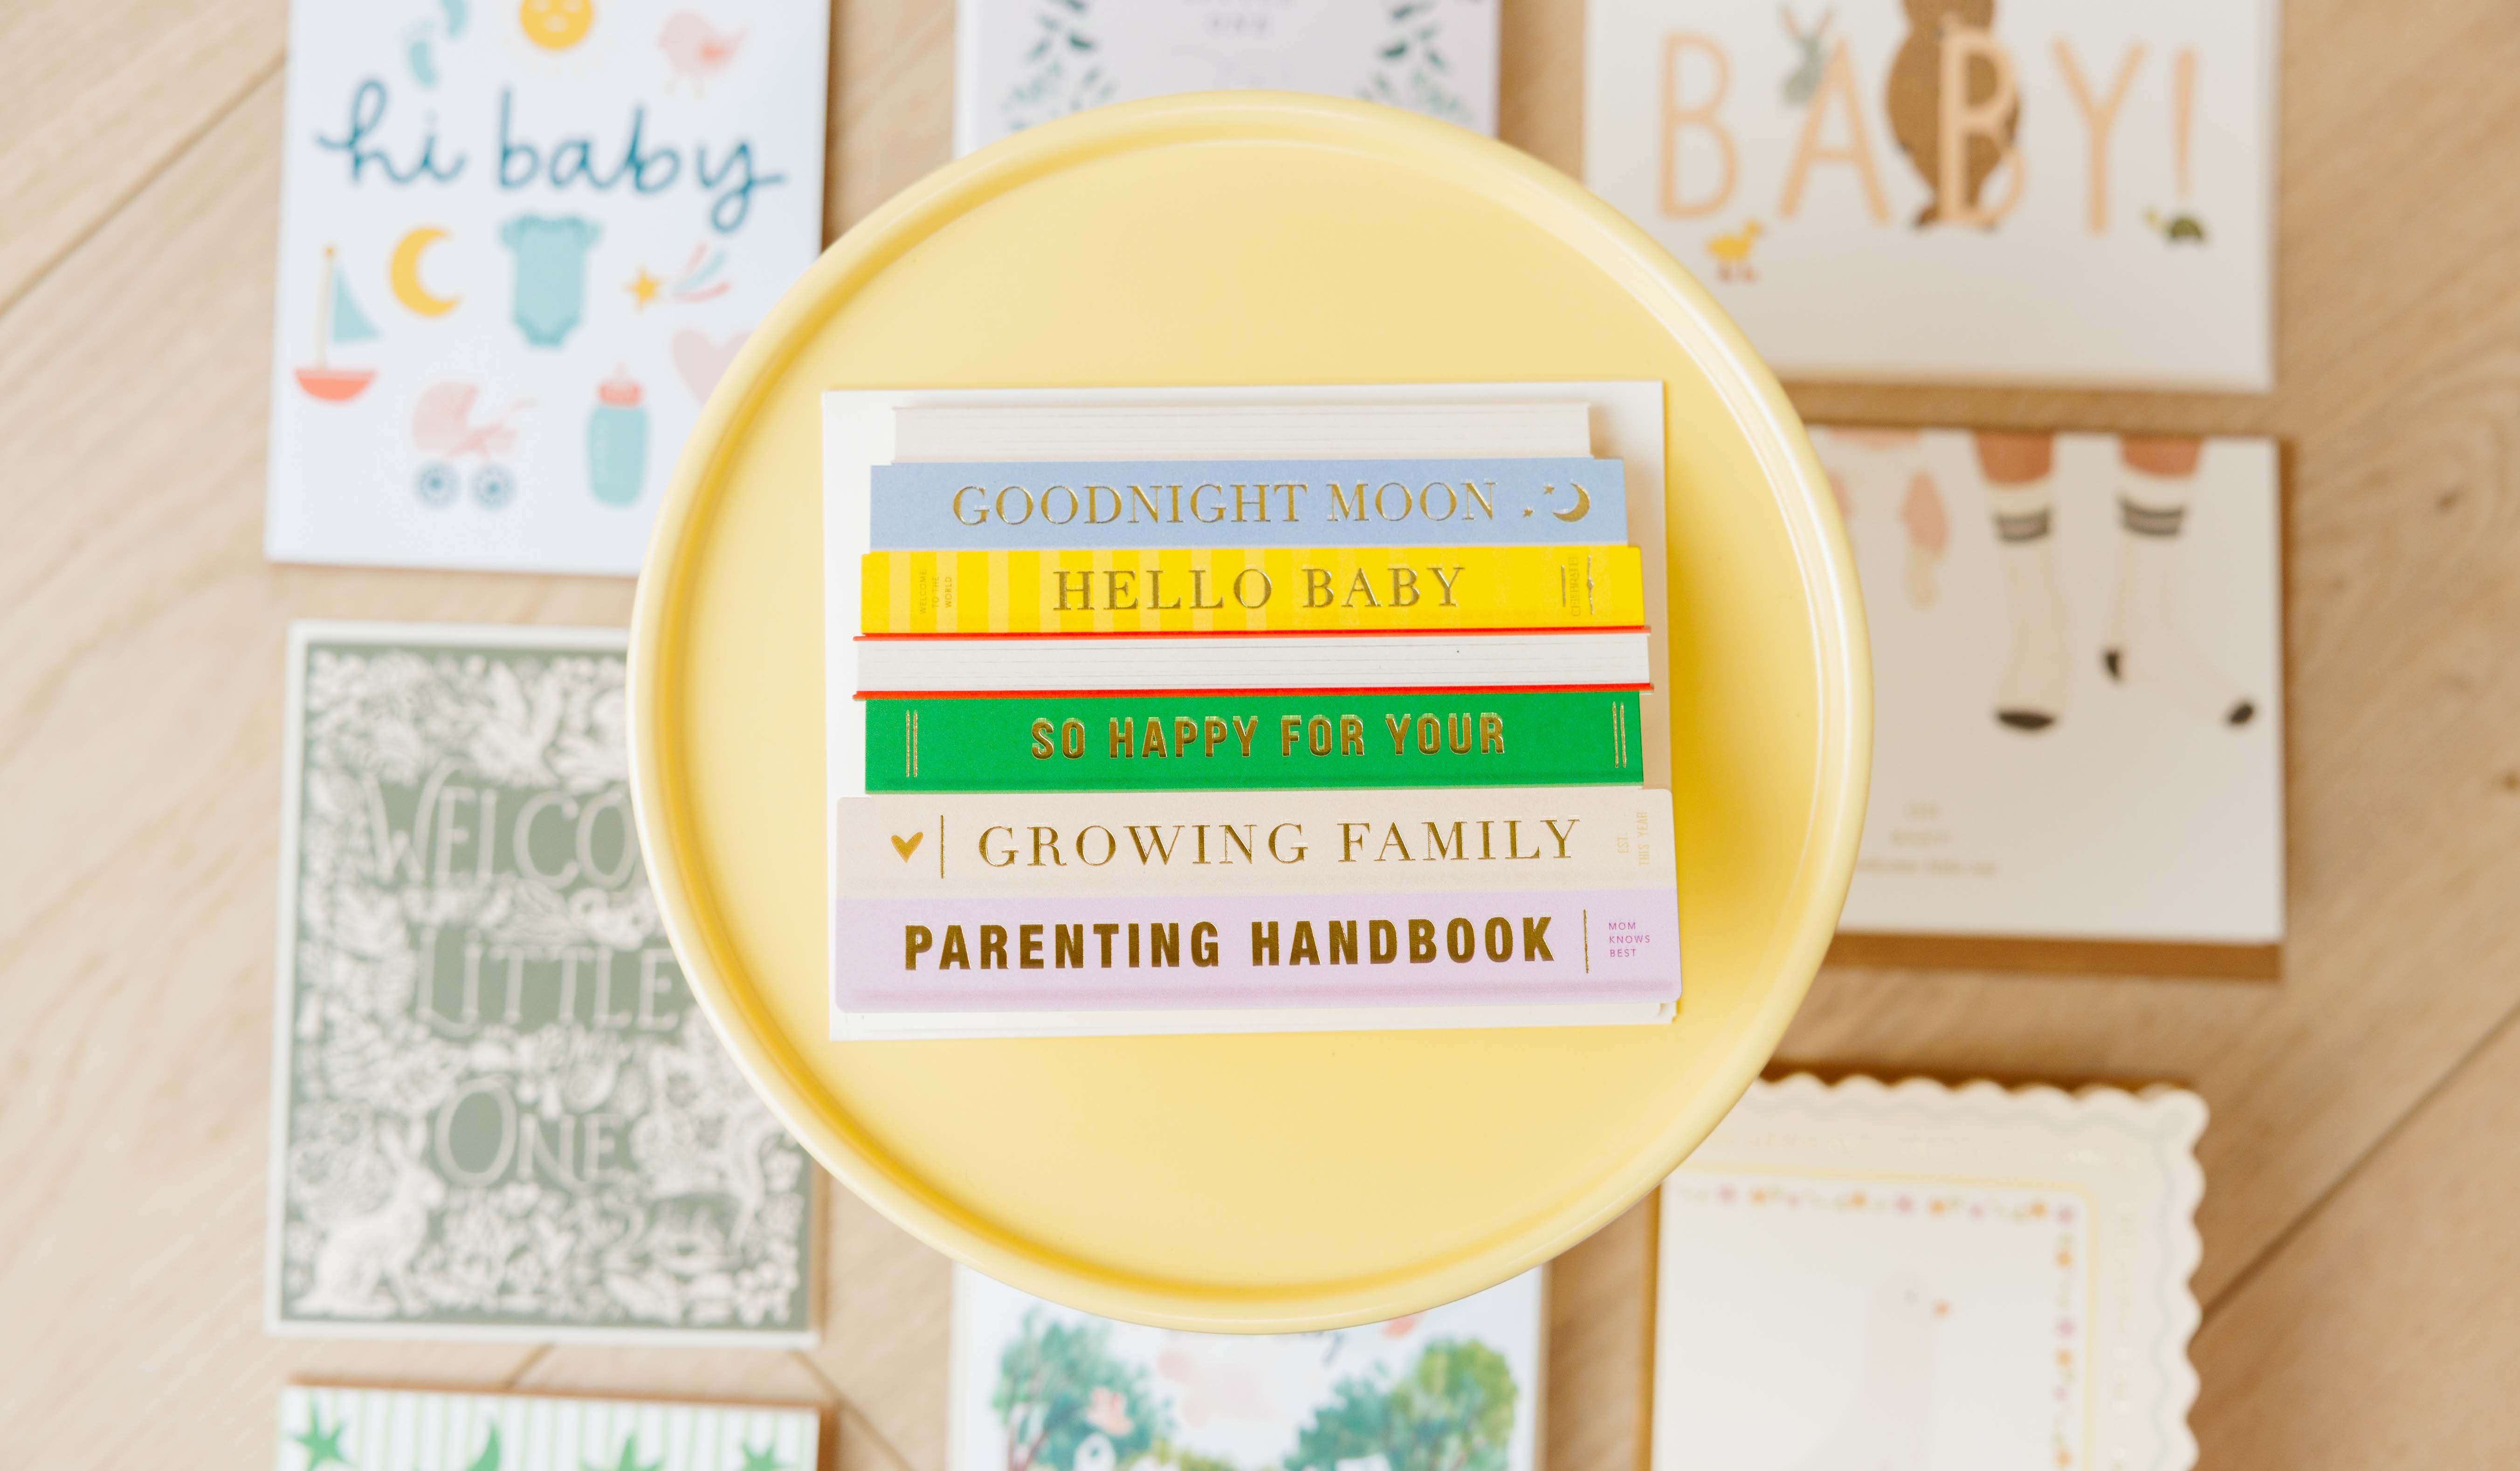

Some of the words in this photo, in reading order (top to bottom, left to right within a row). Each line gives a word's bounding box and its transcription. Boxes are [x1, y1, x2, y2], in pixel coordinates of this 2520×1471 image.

[1657, 26, 2199, 237] BABY!
[315, 79, 468, 186] hi
[498, 86, 787, 235] baby
[952, 483, 1308, 525] GOODNIGHT
[1325, 481, 1497, 522] MOON
[932, 596, 940, 608] TO
[1053, 568, 1273, 610] HELLO
[1302, 566, 1465, 609] BABY
[1031, 718, 1085, 759] SO
[1109, 716, 1260, 758] HAPPY
[1281, 714, 1364, 756] FOR
[1385, 712, 1505, 755] YOUR
[365, 757, 642, 888] WELCO
[979, 823, 1308, 866] GROWING
[1337, 818, 1581, 863] FAMILY
[1636, 812, 1648, 839] YEAR
[1638, 844, 1650, 866] THIS
[905, 921, 1219, 971] PARENTING
[1251, 916, 1555, 967] HANDBOOK
[1609, 921, 1636, 930] MOM
[1609, 935, 1650, 943] KNOWS
[416, 931, 678, 1032] LITTLE
